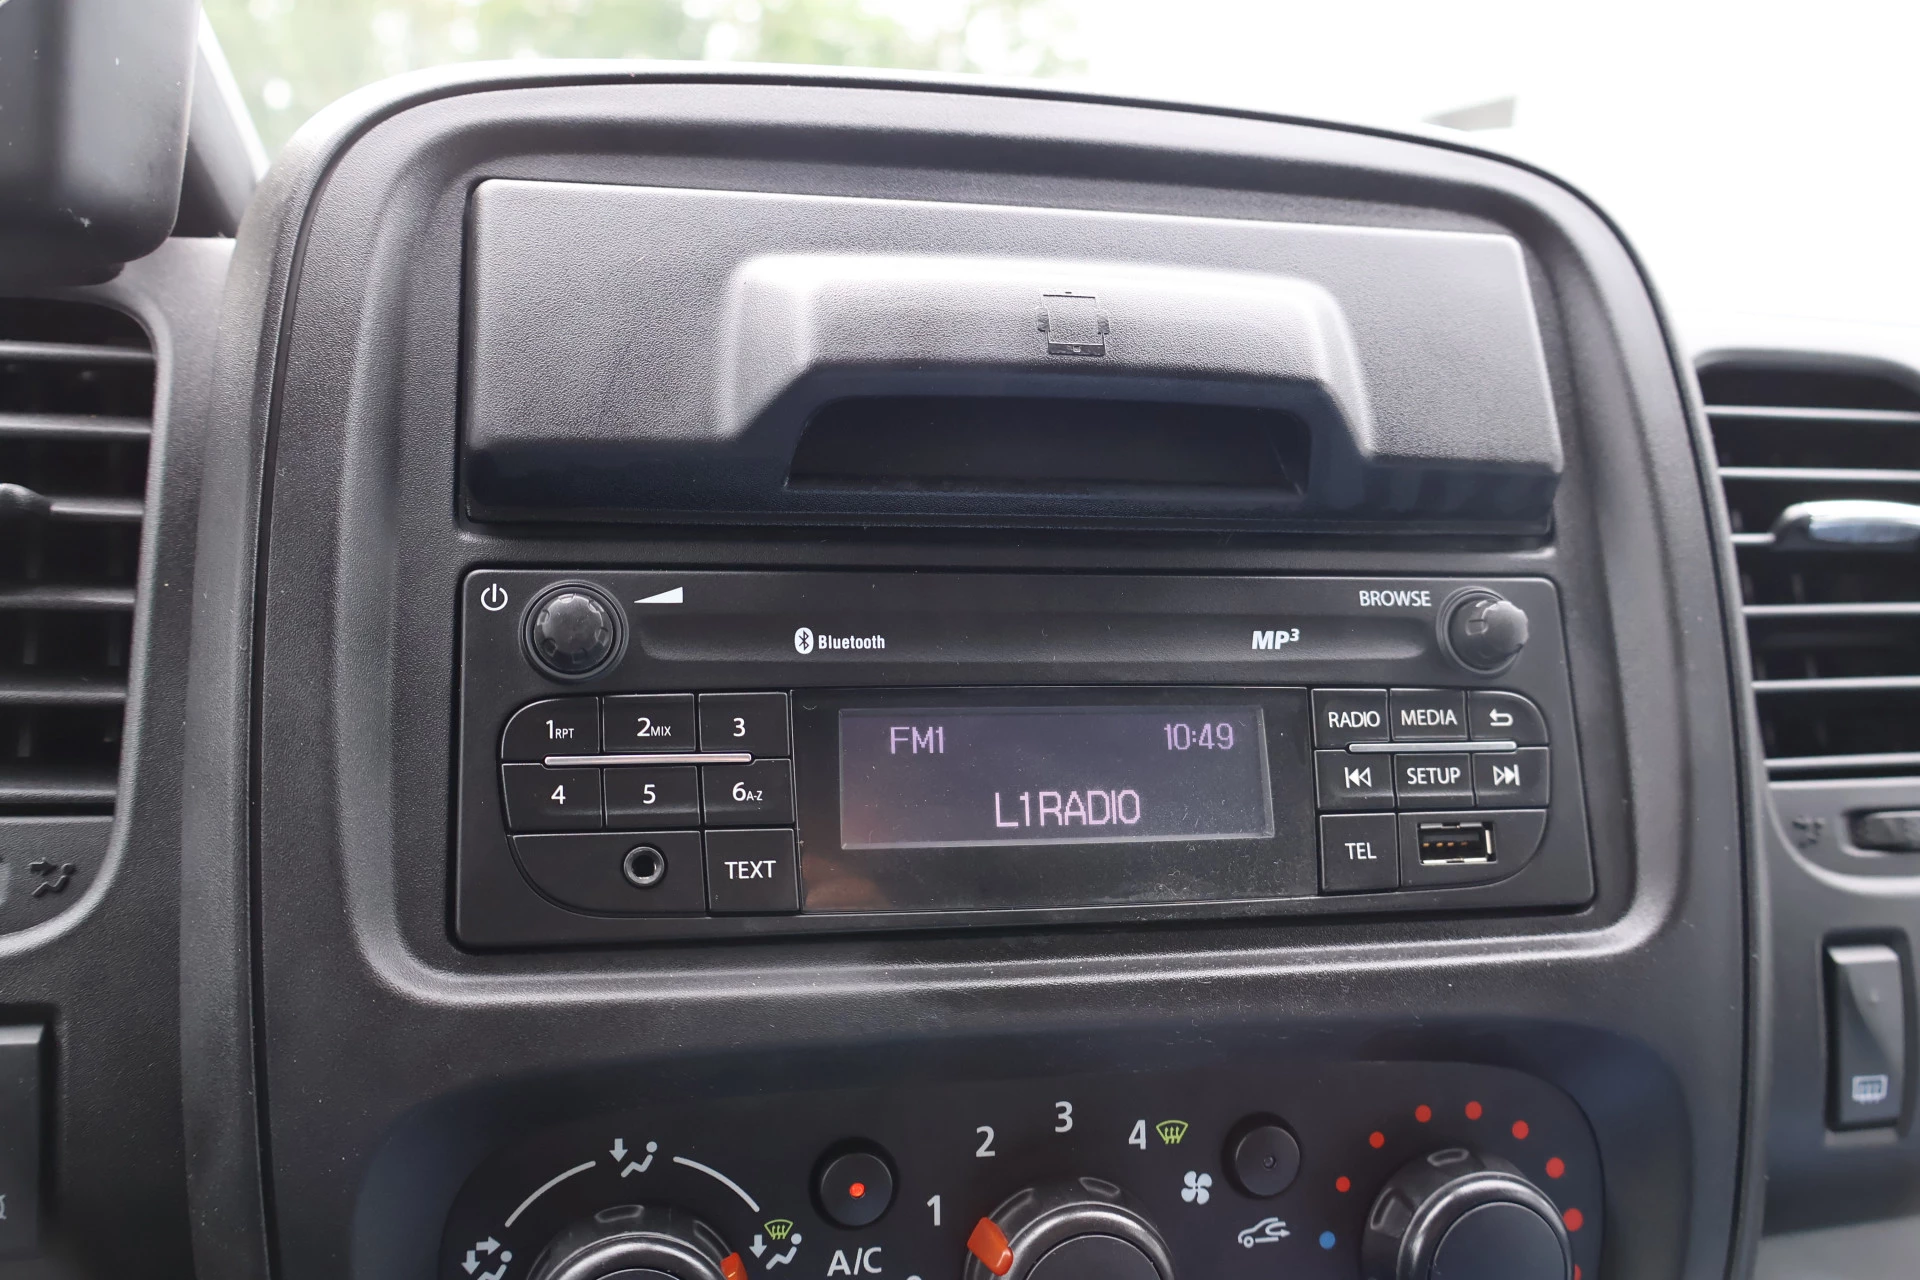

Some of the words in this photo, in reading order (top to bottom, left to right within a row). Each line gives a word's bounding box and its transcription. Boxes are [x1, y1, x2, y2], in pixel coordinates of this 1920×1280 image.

[1358, 590, 1432, 607] BROWSE
[818, 634, 886, 650] Bluetooth
[733, 717, 746, 737] 3
[1328, 710, 1381, 728] RADIO
[1400, 708, 1458, 726] MEDIA
[890, 726, 944, 755] FM1
[1164, 722, 1234, 751] 10:49
[1406, 766, 1461, 785] SETUP
[550, 784, 566, 805] 4
[642, 783, 656, 805] 5
[1344, 841, 1378, 860] TEL
[724, 860, 777, 880] TEXT
[1054, 1100, 1073, 1133] 3
[975, 1125, 996, 1158] 2
[1128, 1119, 1147, 1150] 4
[926, 1194, 941, 1227] 1
[826, 1246, 882, 1277] A/C
